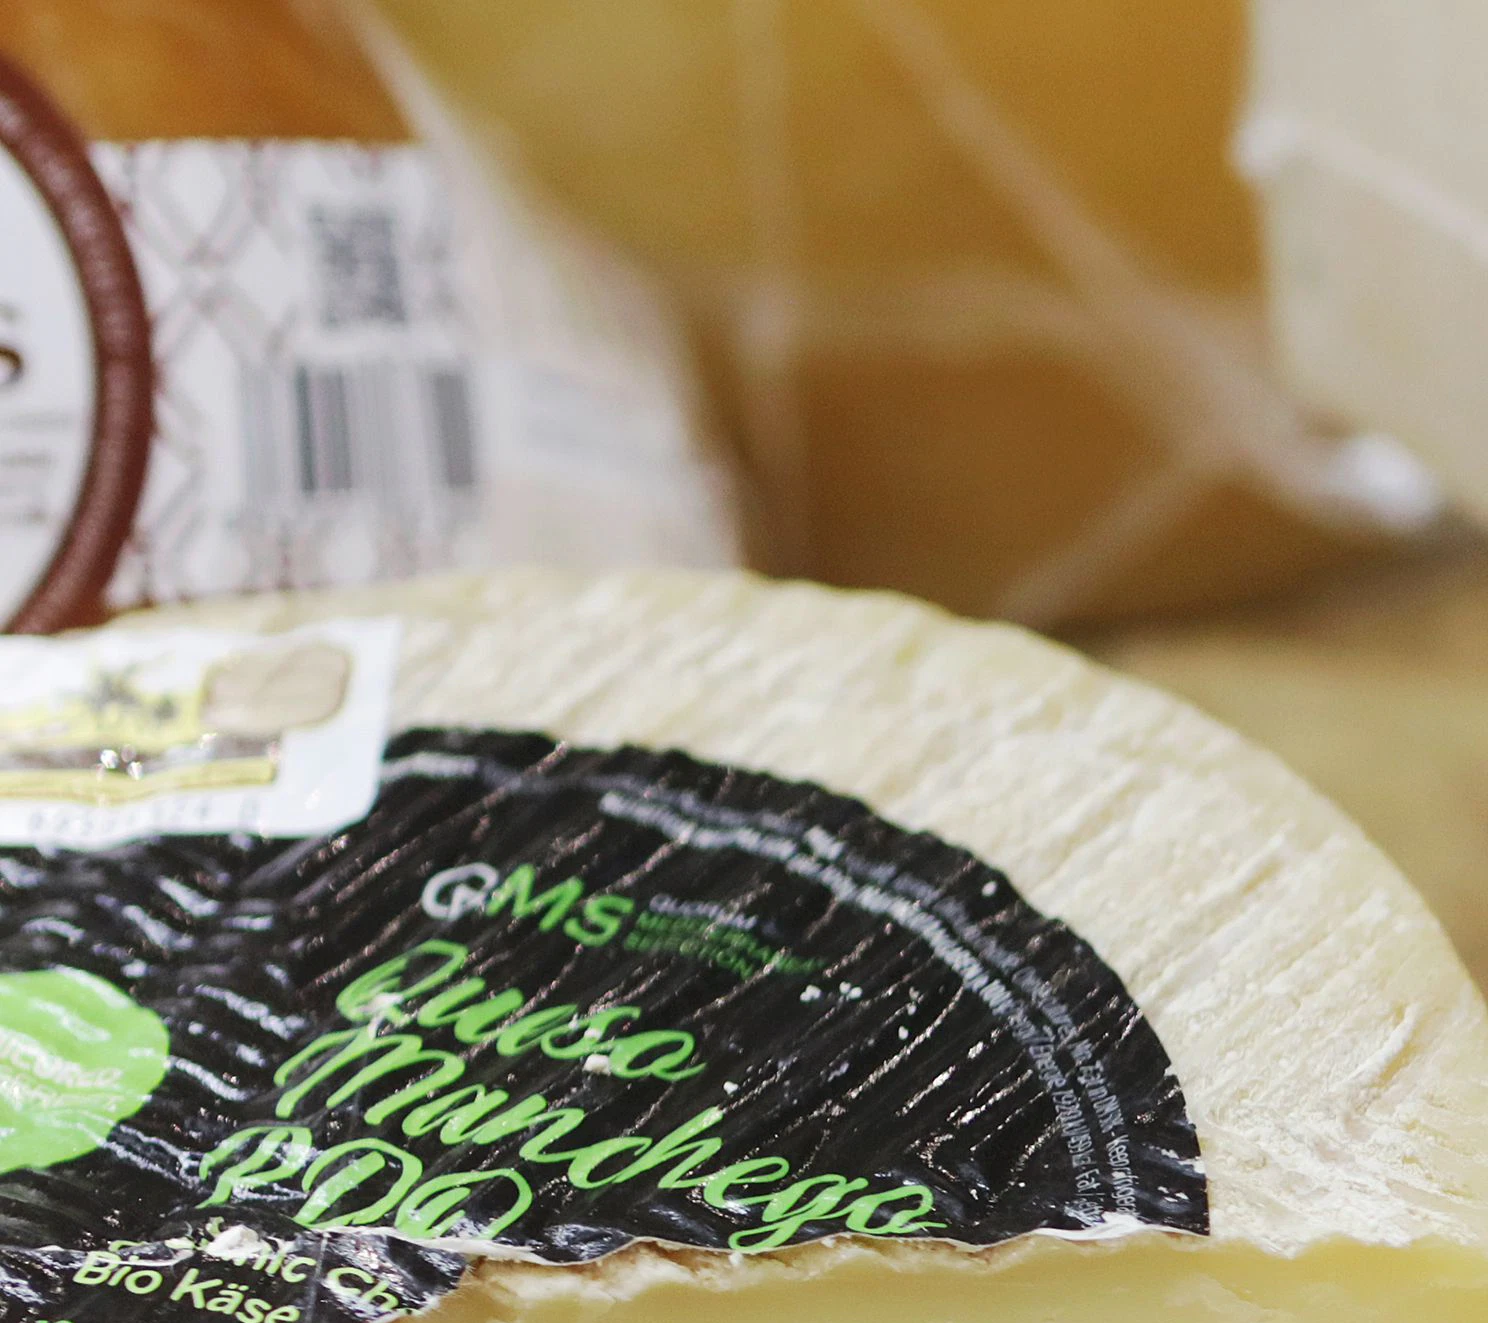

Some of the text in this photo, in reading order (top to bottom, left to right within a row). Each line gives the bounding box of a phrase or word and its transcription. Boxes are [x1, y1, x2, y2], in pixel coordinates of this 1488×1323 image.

[337, 939, 705, 1082] Queso
[275, 1033, 947, 1252] Manchego
[73, 1251, 163, 1295] Bio
